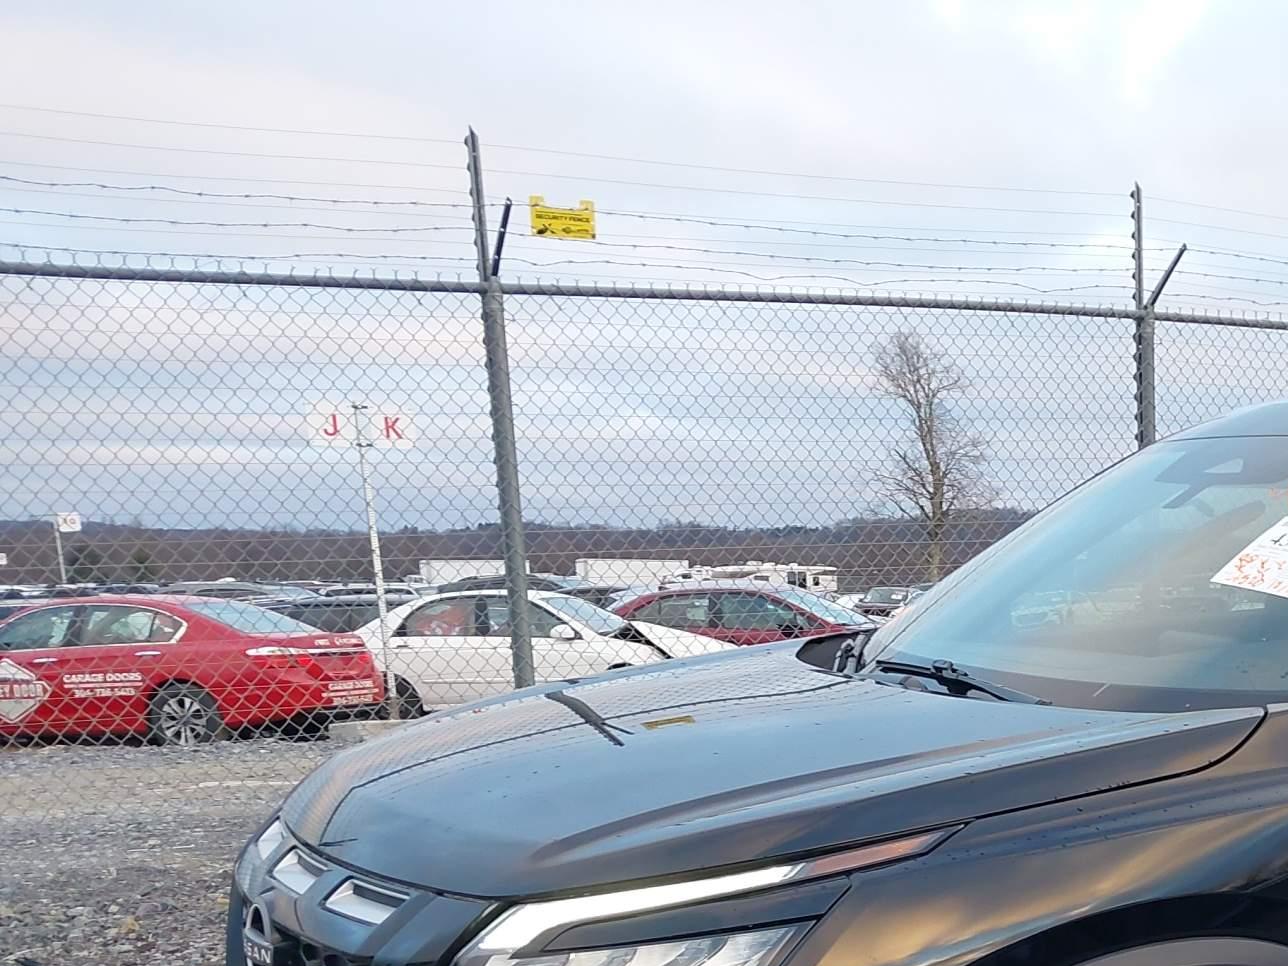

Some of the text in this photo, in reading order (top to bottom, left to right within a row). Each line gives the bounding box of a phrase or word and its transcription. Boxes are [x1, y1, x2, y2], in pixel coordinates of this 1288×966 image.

[323, 414, 339, 436] J
[384, 416, 402, 439] K
[62, 671, 143, 683] GARAGE DOORS
[13, 682, 44, 697] DOOR
